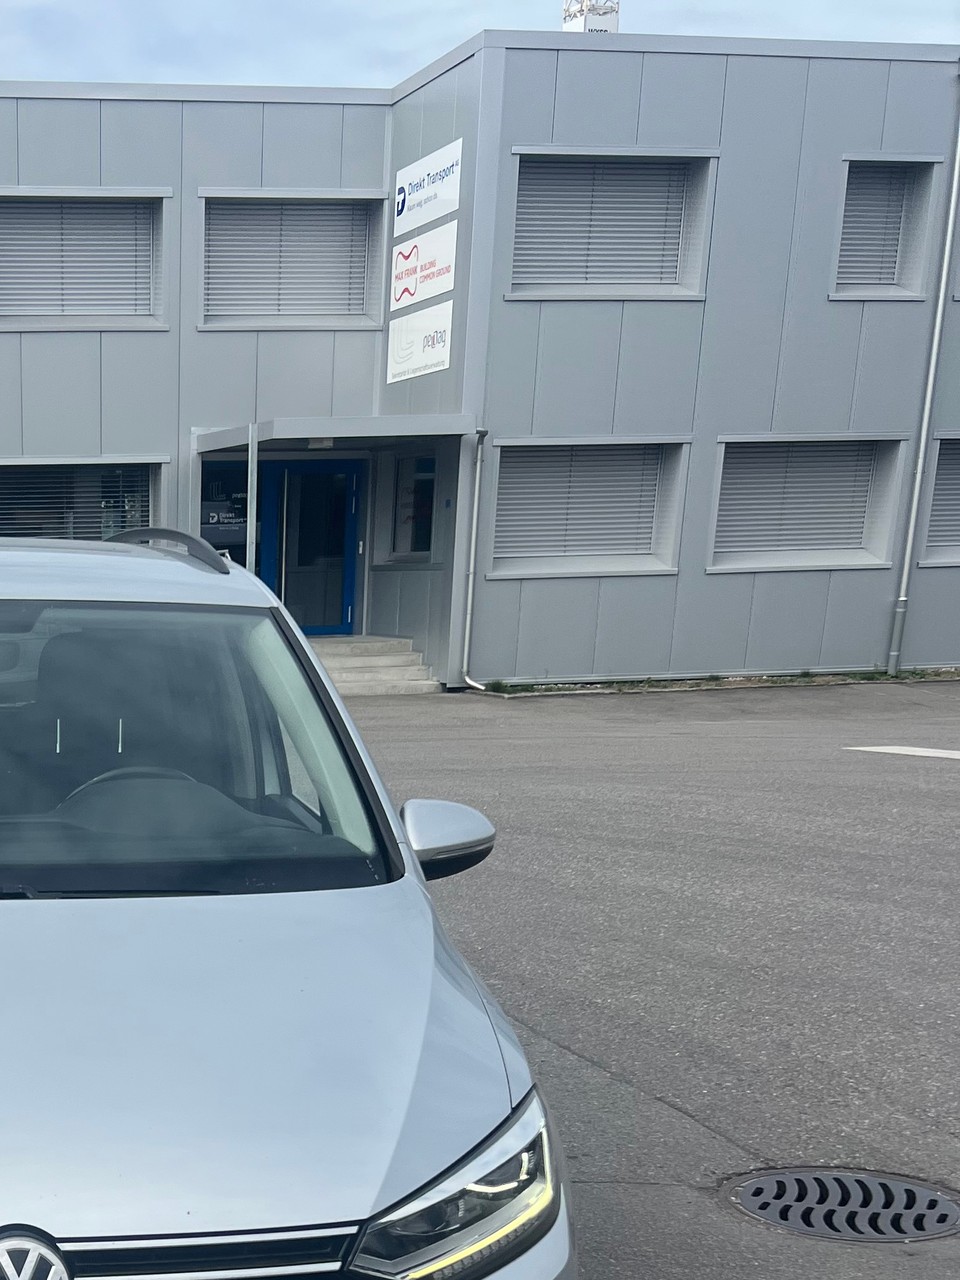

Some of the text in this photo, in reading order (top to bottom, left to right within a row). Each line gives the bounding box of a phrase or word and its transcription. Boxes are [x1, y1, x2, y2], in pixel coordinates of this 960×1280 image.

[408, 177, 425, 196] Direkt
[426, 162, 455, 185] Transport
[404, 265, 418, 279] FRANK
[419, 264, 451, 284] COMMON GROUND
